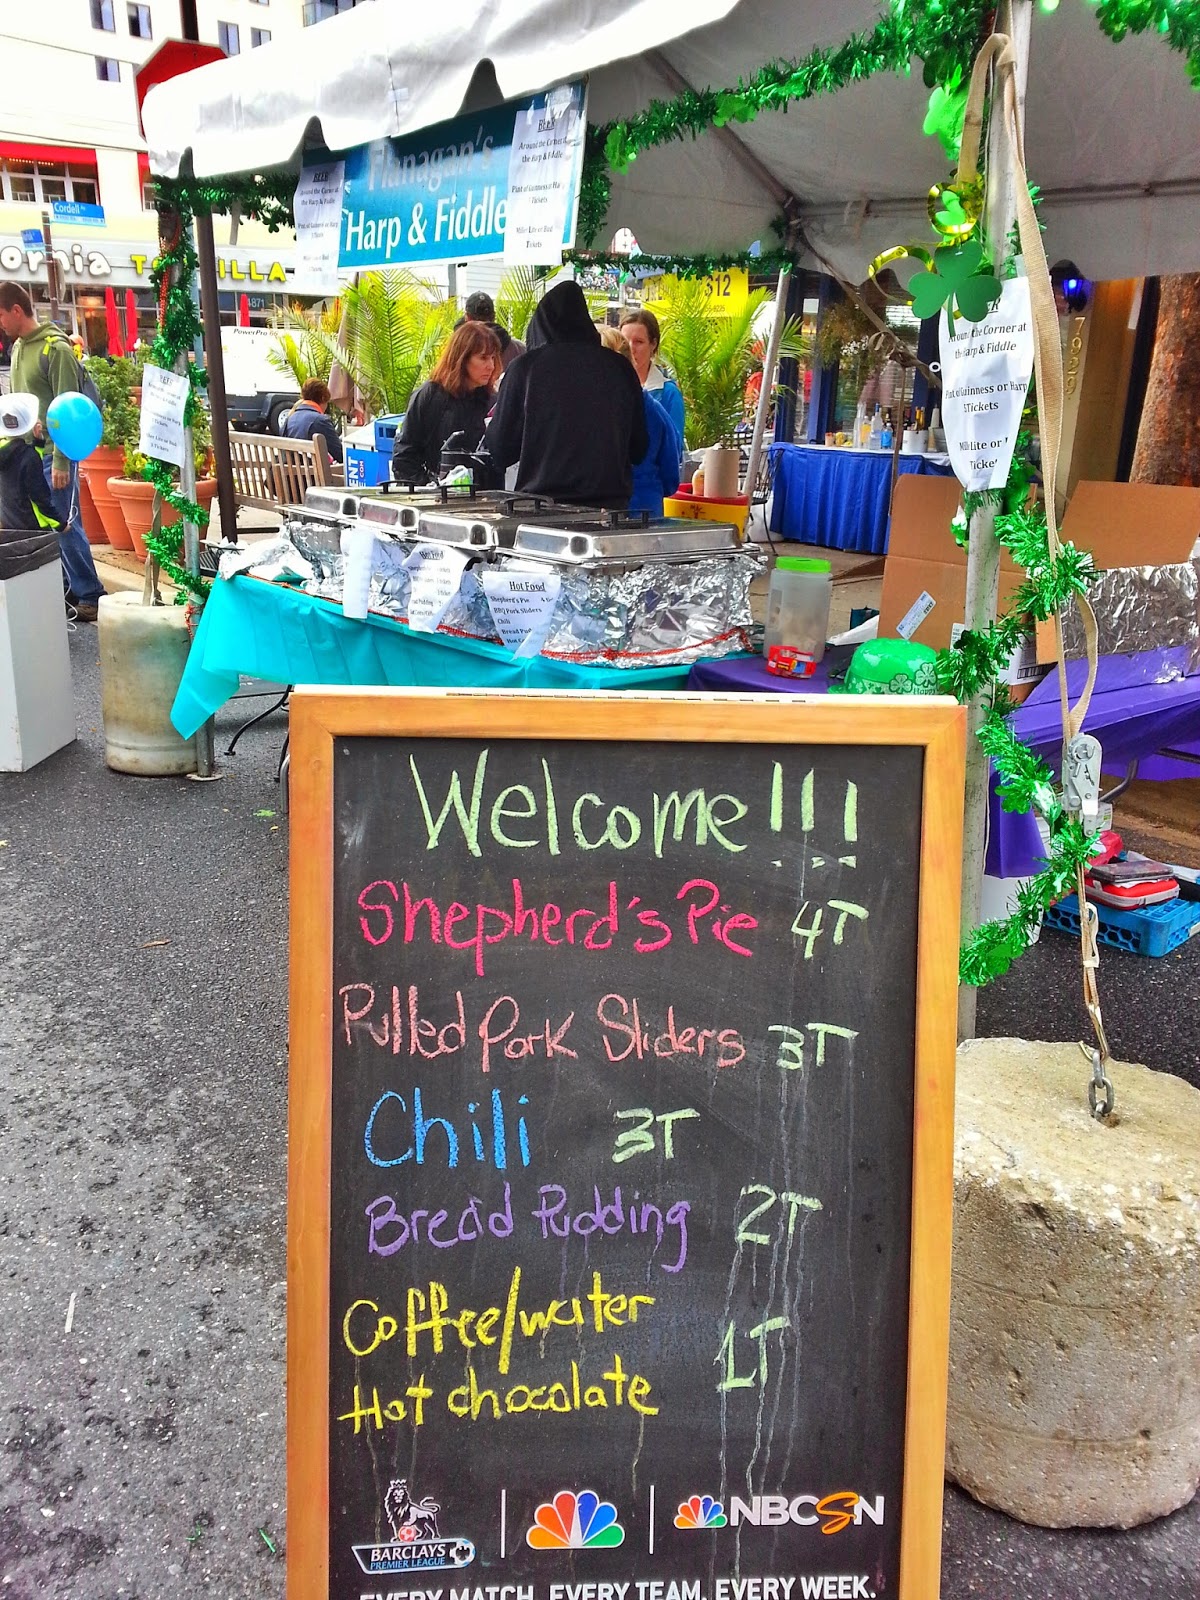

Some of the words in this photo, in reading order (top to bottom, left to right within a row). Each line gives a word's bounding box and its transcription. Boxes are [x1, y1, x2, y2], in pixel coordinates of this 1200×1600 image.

[368, 125, 494, 192] Flanagan's
[54, 202, 80, 214] Cordell
[345, 210, 401, 259] Harp
[407, 202, 427, 246] &
[434, 185, 507, 242] Fiddle
[983, 324, 1017, 336] Corner
[1018, 322, 1027, 332] at
[979, 343, 985, 354] &
[987, 341, 1017, 353] Fiddle
[997, 383, 1009, 392] or
[1010, 380, 1028, 393] Harp
[970, 440, 987, 451] Lite
[990, 440, 1002, 448] or
[509, 581, 524, 591] Hot
[524, 582, 546, 592] Food
[357, 879, 673, 976] Shepherd's
[676, 879, 758, 957] Pie
[791, 900, 869, 958] 4T
[338, 982, 466, 1059] Pulled
[479, 995, 578, 1072] Pork
[598, 993, 746, 1069] Sliders
[768, 1022, 860, 1070] 3T
[365, 1087, 530, 1169] Chili
[612, 1107, 700, 1163] 3T
[365, 1181, 513, 1257] Bread
[532, 1184, 691, 1272] Pudding
[736, 1184, 823, 1245] 2T
[338, 1374, 432, 1434] Hot
[730, 1491, 885, 1534] NBCSN
[370, 1543, 446, 1562] BARCLAYS
[370, 1559, 409, 1570] PREMIER
[411, 1557, 446, 1568] LEAGUE
[550, 1582, 631, 1600] EVERY
[716, 1577, 796, 1600] EVERY
[800, 1576, 876, 1600] WEEK.
